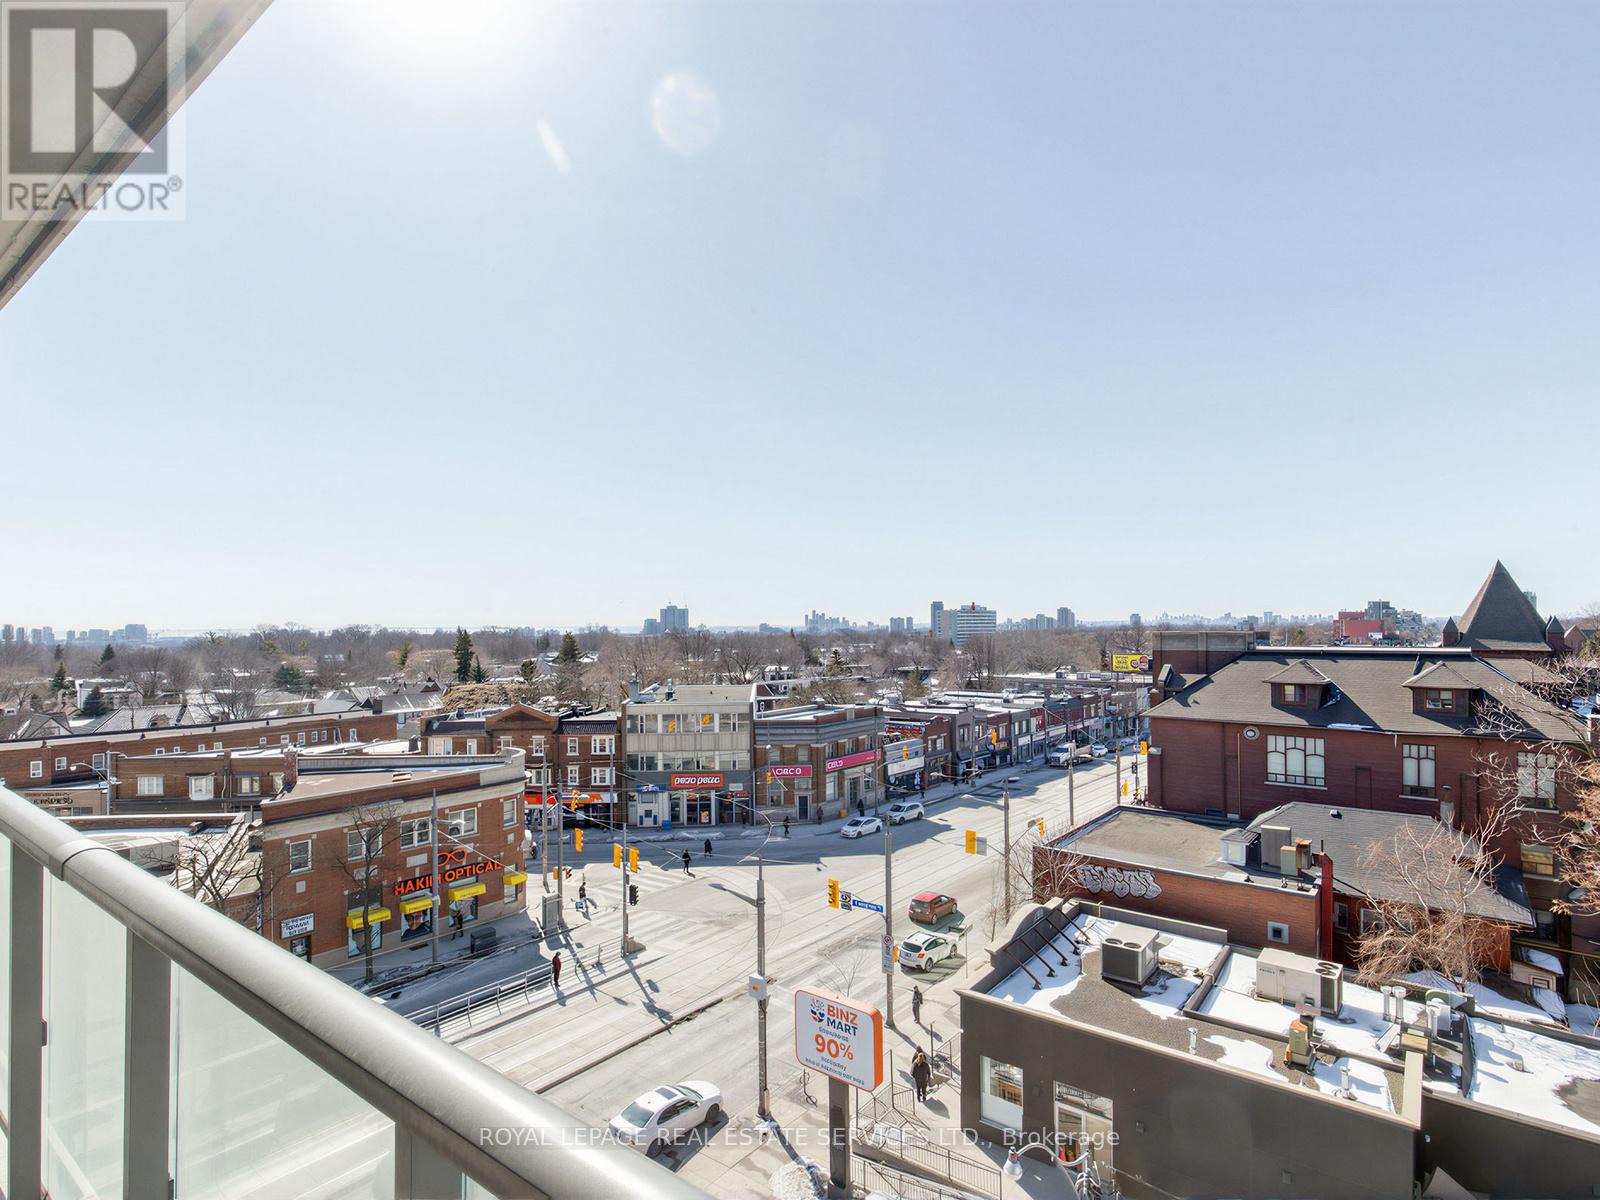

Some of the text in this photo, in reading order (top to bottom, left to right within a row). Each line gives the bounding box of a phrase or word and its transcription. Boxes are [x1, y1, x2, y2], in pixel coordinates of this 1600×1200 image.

[444, 859, 503, 883] OPTICAL
[826, 1004, 858, 1026] BINZ
[826, 1017, 858, 1036] MART
[814, 1033, 854, 1061] 90%
